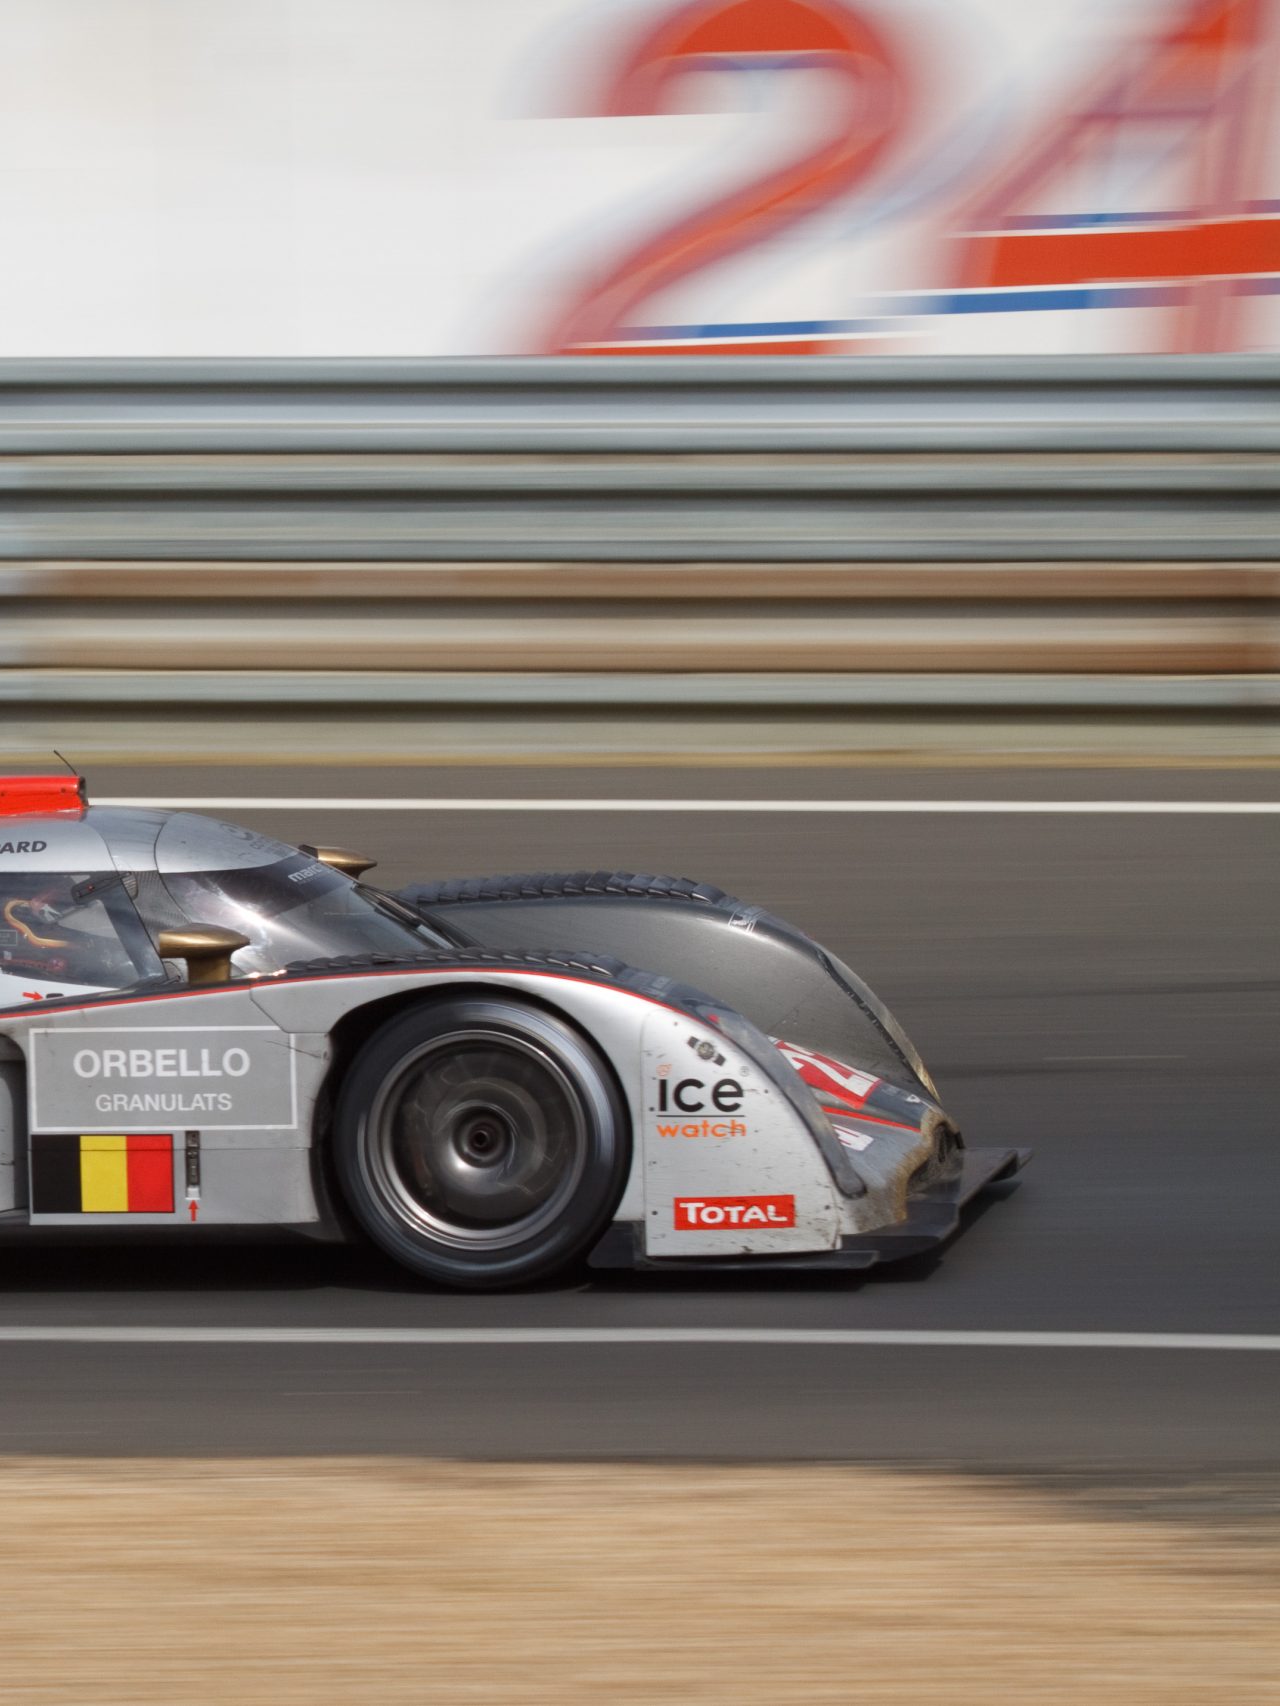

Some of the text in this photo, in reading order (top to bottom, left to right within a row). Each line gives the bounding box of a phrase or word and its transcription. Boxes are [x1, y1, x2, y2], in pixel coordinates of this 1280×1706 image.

[520, 0, 1280, 355] 24
[73, 1047, 251, 1079] ORBELLO
[95, 1092, 233, 1112] GRANULATS
[656, 1066, 744, 1113] ice
[656, 1119, 747, 1138] watch
[679, 1202, 789, 1225] TOTAL
